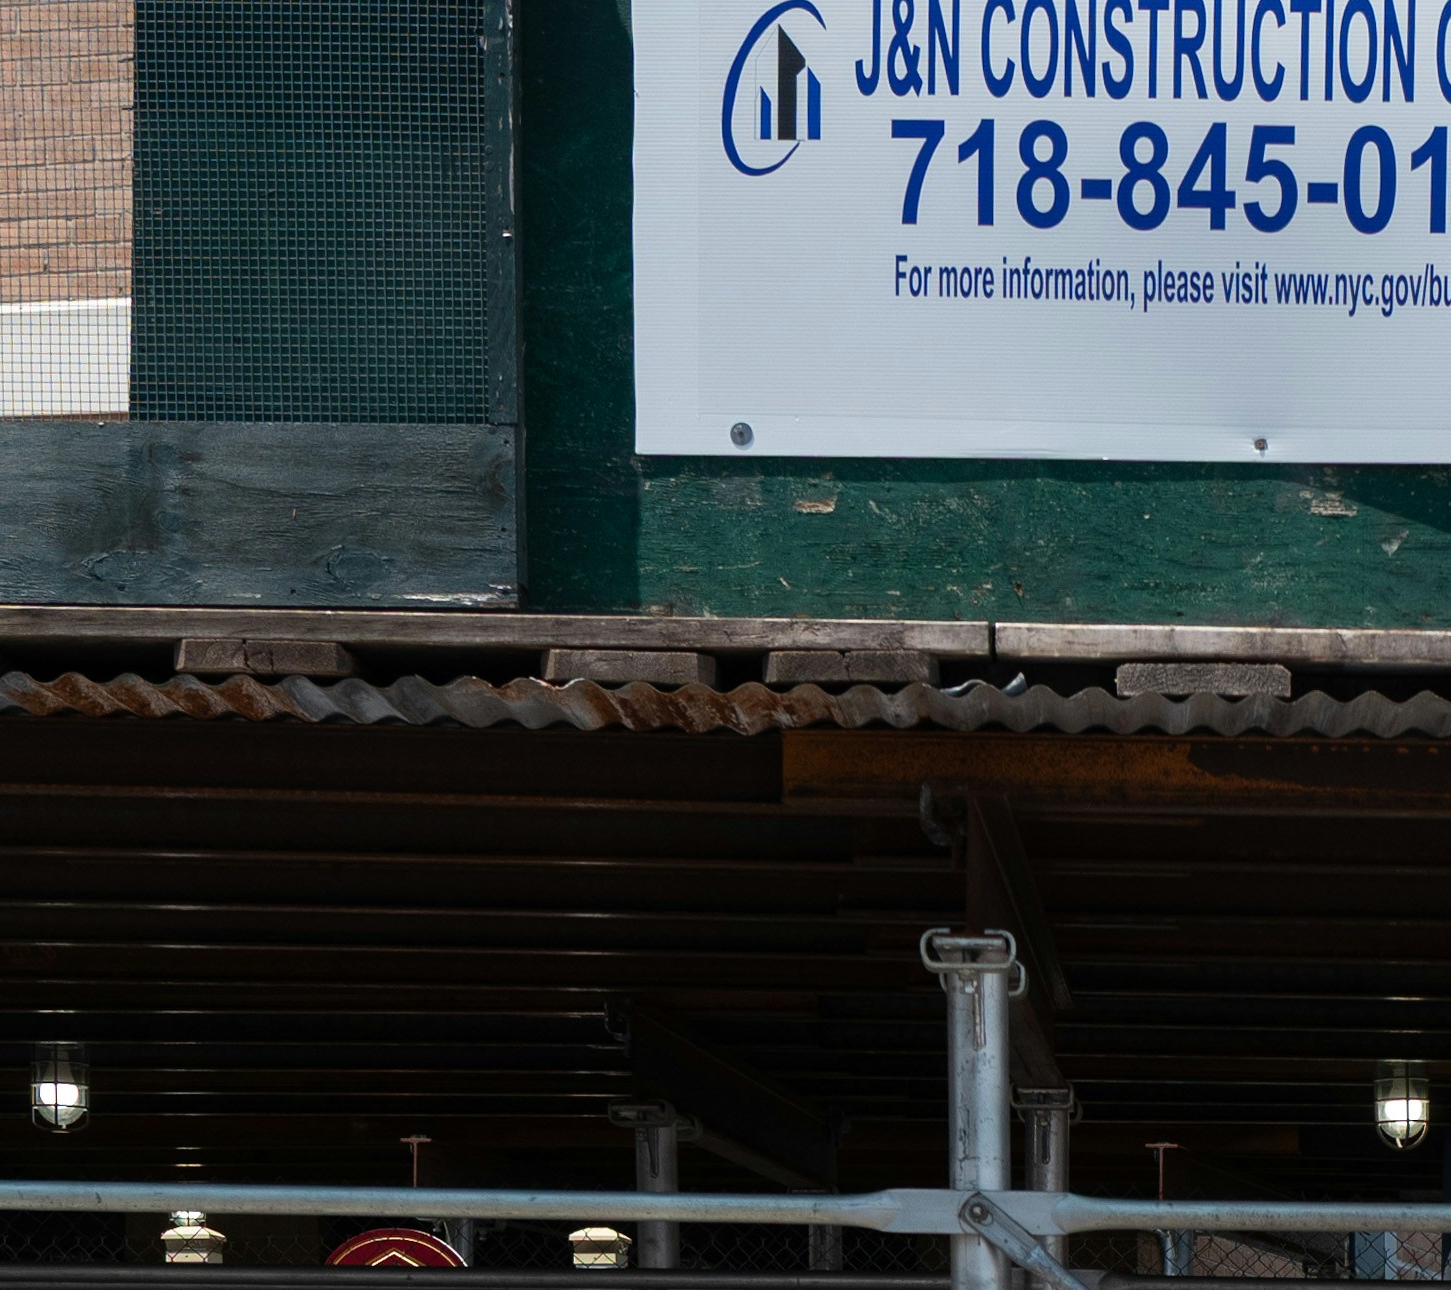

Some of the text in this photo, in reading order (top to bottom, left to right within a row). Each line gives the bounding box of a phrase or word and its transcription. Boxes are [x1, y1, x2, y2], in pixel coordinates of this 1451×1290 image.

[854, 0, 961, 97] J&N
[980, 0, 1418, 104] CONSTRUCTION
[895, 254, 933, 297] For
[938, 265, 995, 299] more
[1002, 255, 1136, 308] information,
[1143, 259, 1215, 311] please
[1221, 260, 1269, 305] visit
